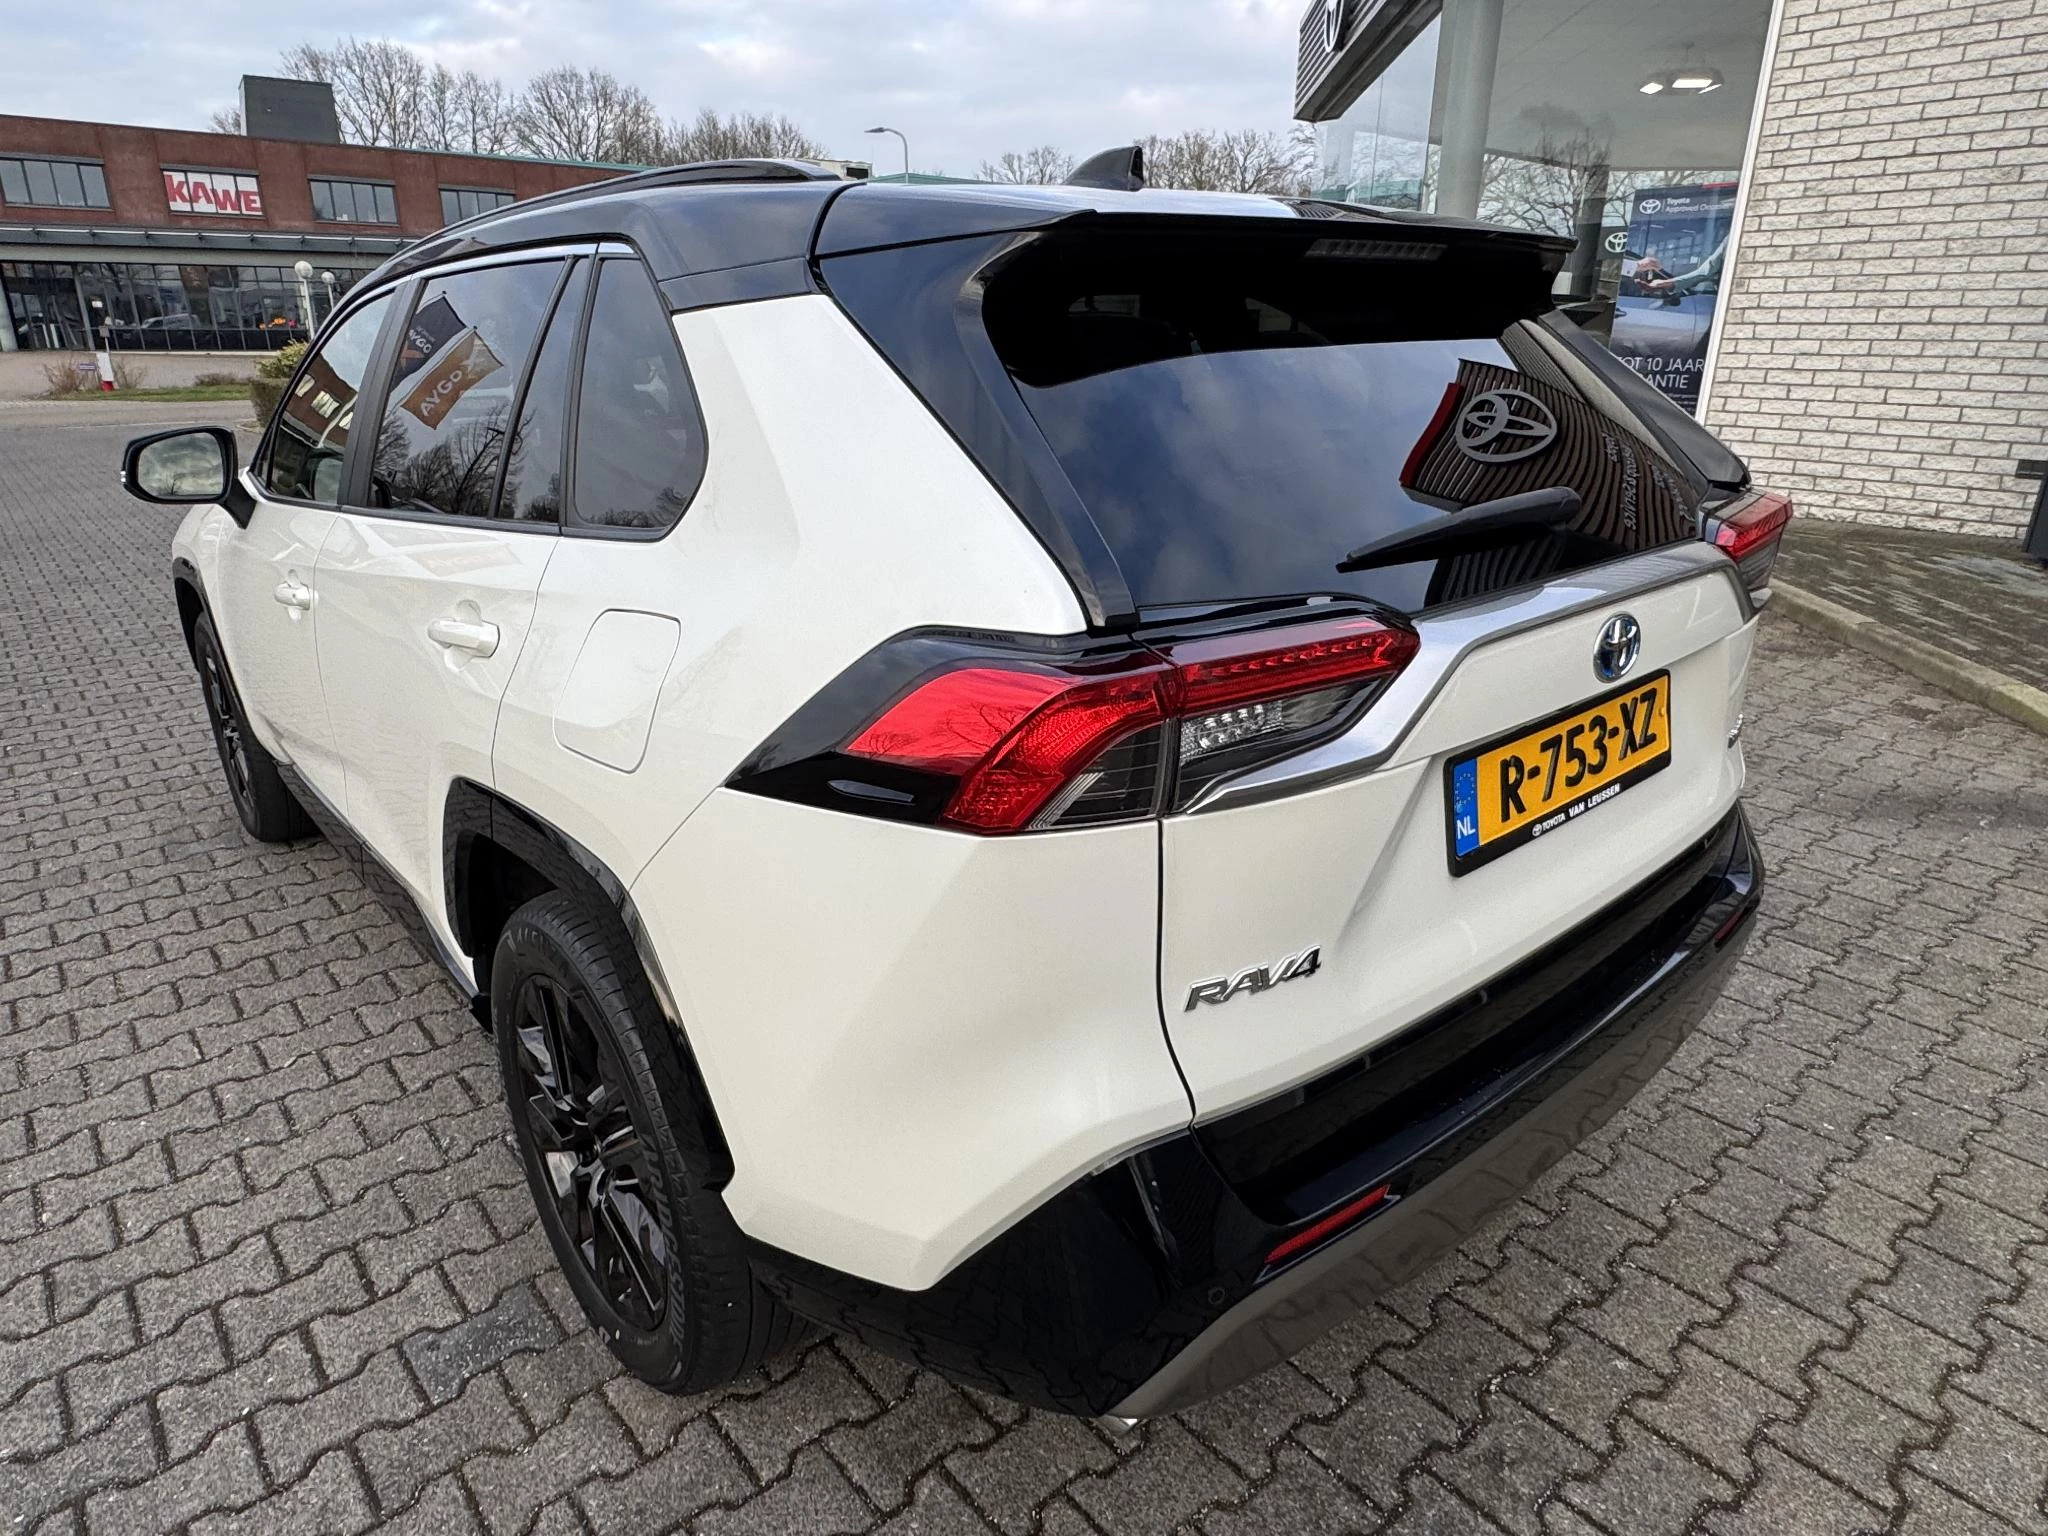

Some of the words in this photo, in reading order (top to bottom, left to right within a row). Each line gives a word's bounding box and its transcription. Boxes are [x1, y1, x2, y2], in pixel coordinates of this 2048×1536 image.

[163, 174, 261, 212] KAWE
[1618, 356, 1643, 370] OT
[1646, 357, 1663, 371] 10
[1665, 358, 1704, 372] JAAR
[420, 370, 462, 417] AYGO
[1501, 687, 1658, 824] R-753-XZ
[1457, 815, 1476, 840] NL
[1542, 812, 1566, 831] TOYOTA
[1568, 801, 1585, 818] VAN
[1587, 783, 1620, 808] LEUSSEN
[1184, 943, 1322, 1012] RAV4
